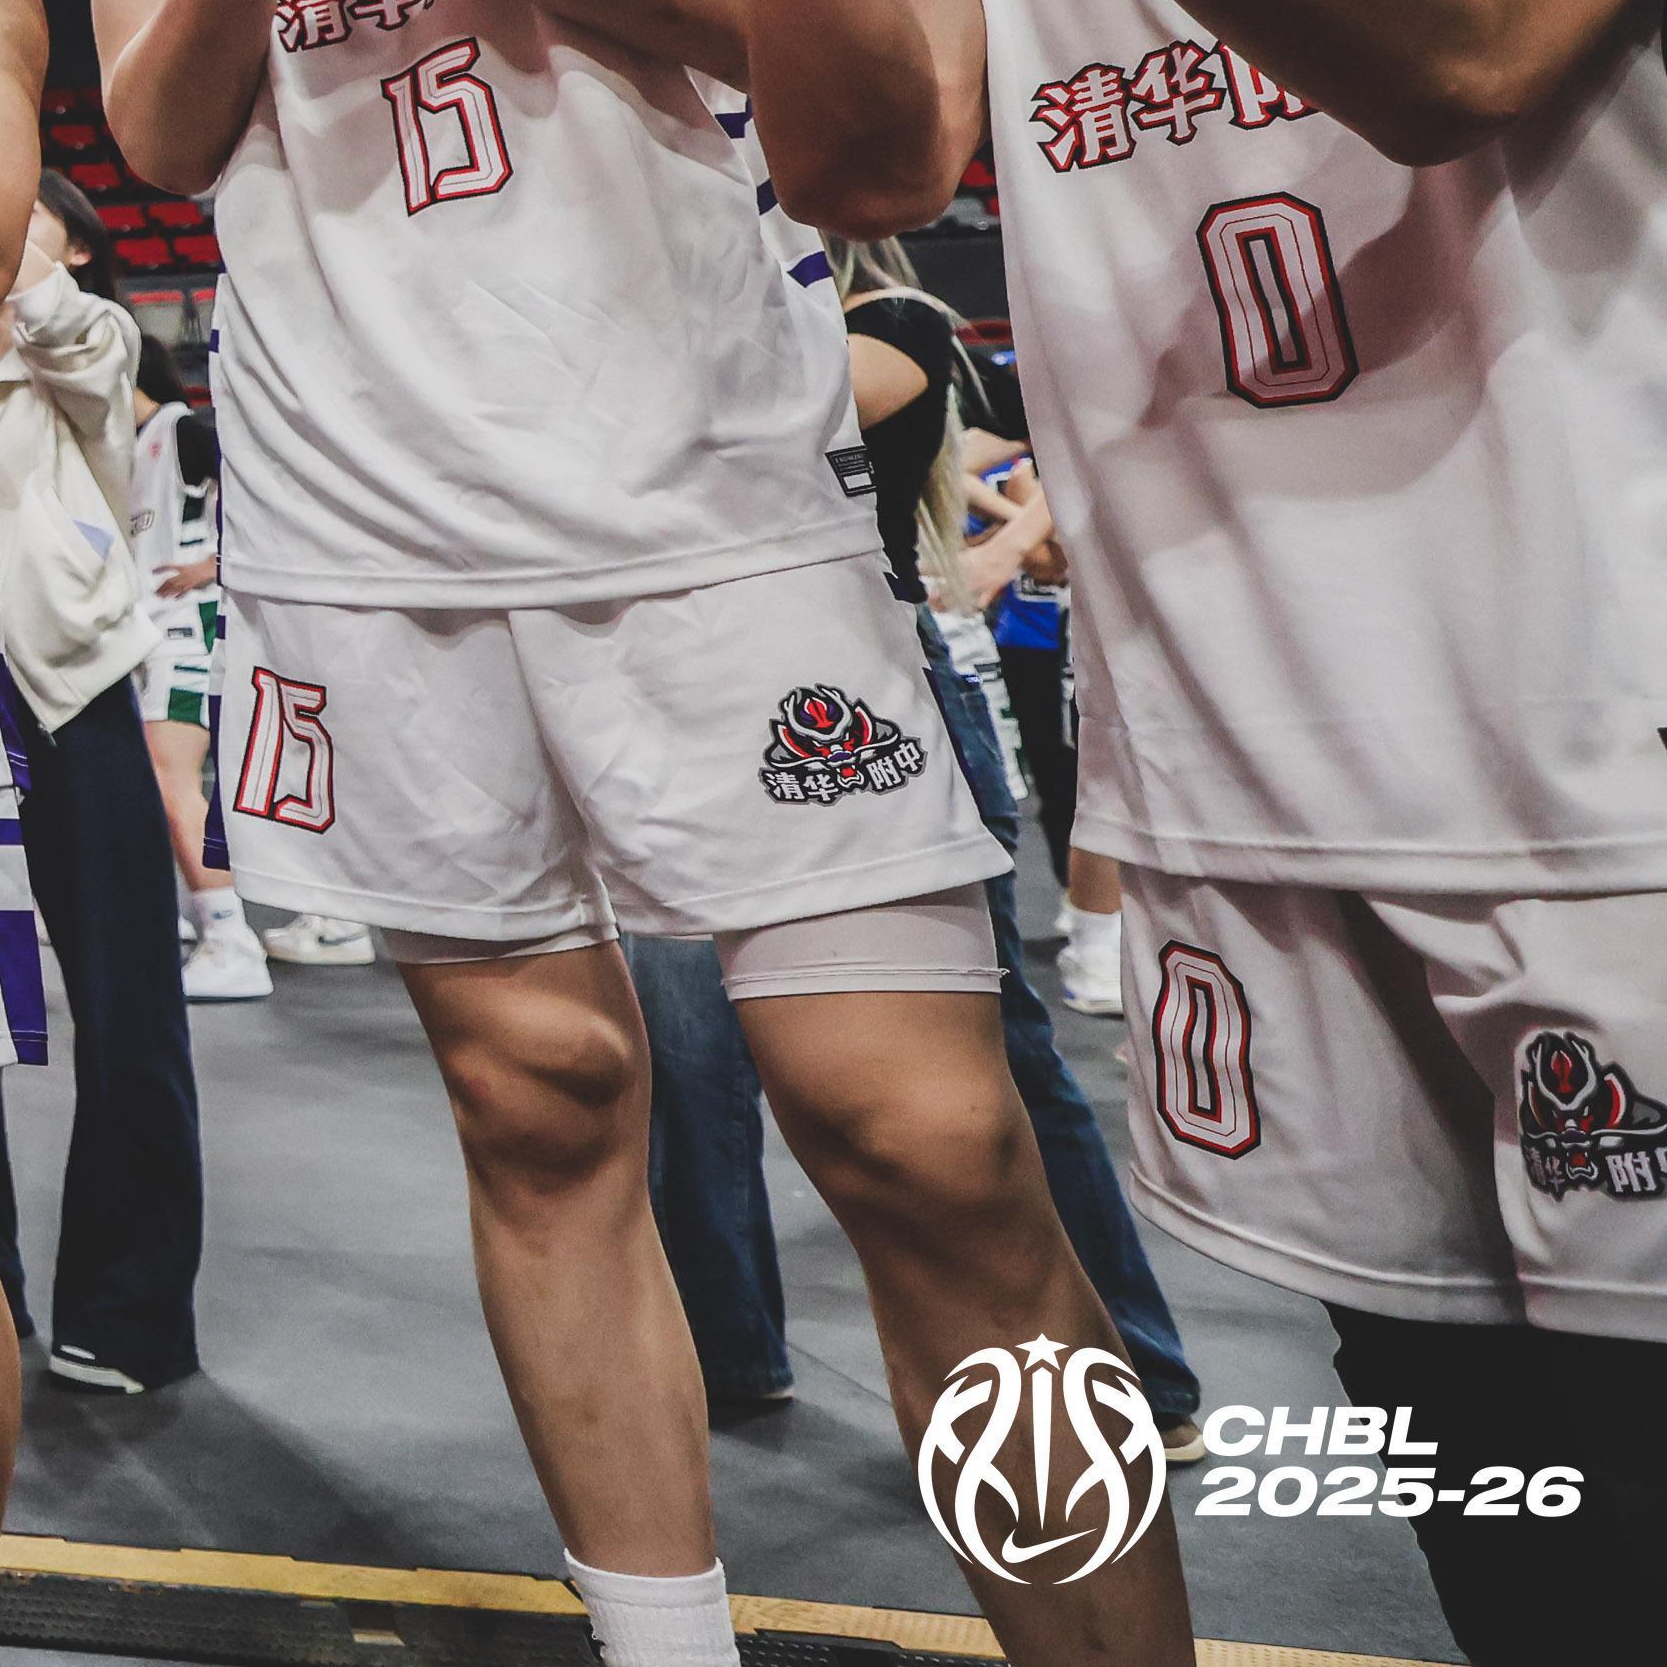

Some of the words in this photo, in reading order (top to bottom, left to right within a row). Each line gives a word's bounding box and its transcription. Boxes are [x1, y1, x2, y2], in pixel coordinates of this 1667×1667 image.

[380, 38, 513, 216] 15
[1196, 191, 1359, 409] 0
[232, 666, 338, 835] 15
[764, 737, 925, 805] 清华附中
[1152, 939, 1262, 1161] 0
